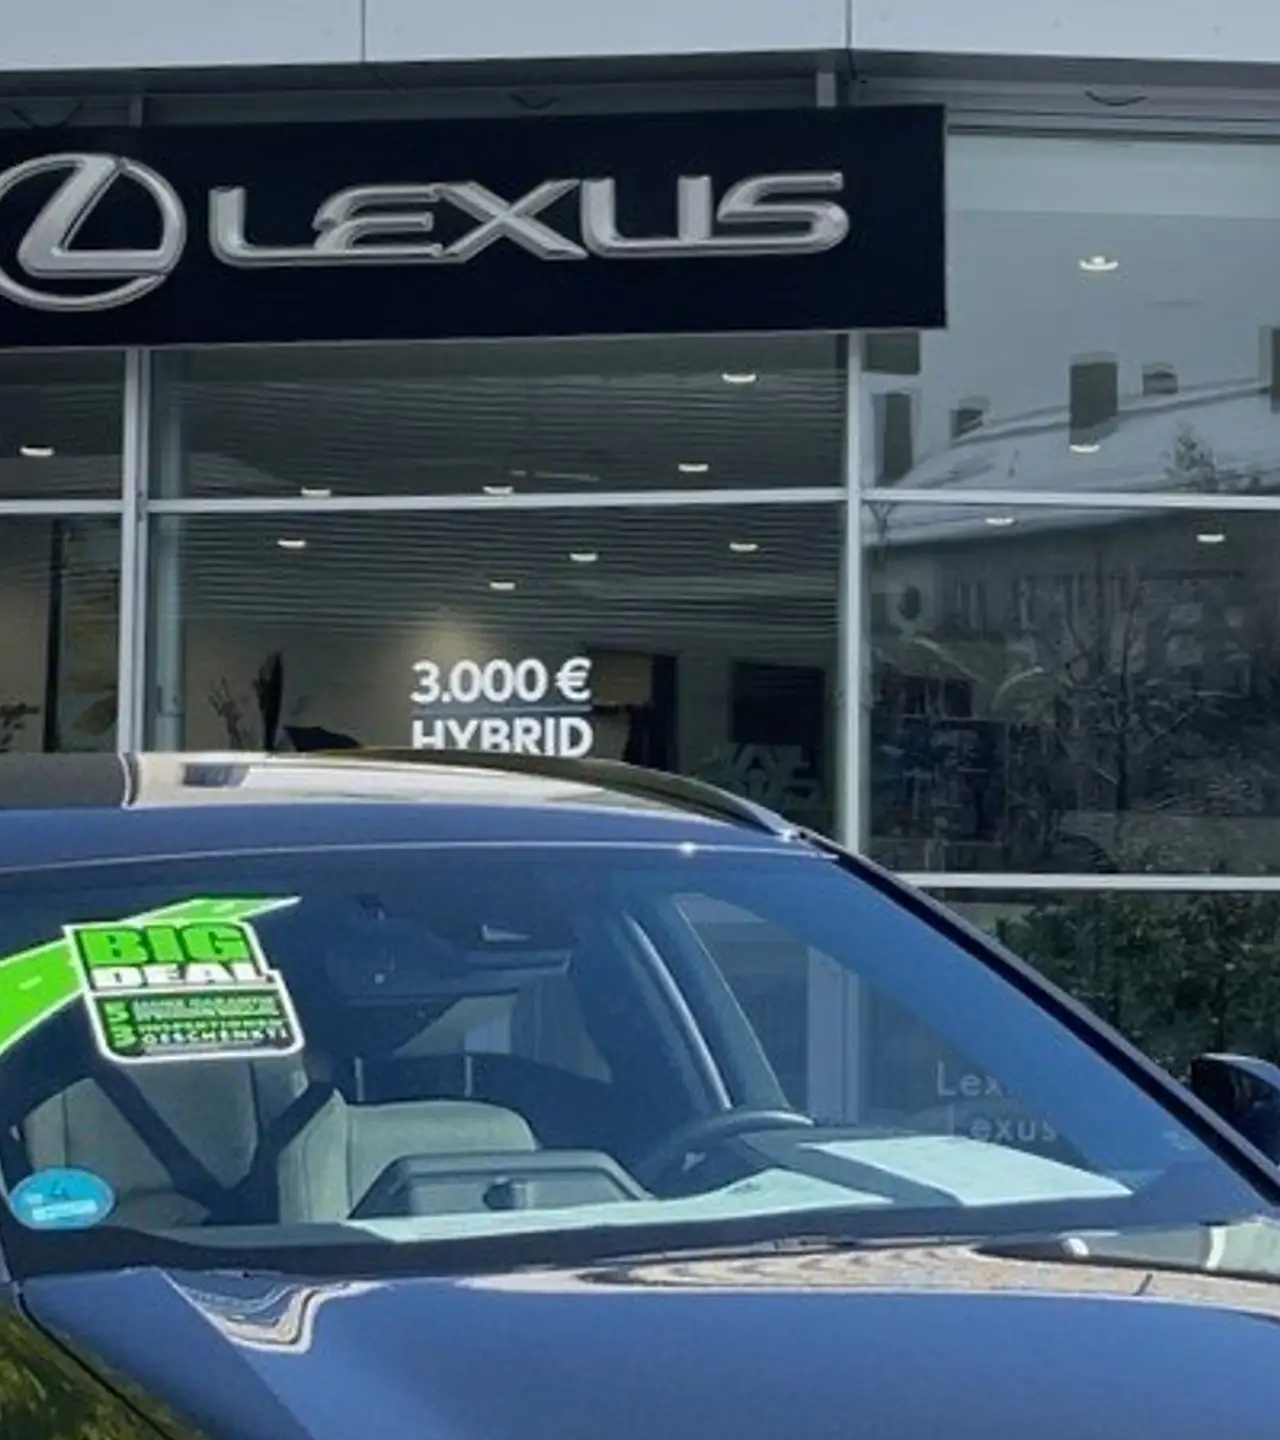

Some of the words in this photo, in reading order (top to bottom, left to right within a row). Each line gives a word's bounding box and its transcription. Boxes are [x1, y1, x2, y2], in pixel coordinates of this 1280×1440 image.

[209, 172, 850, 267] LEXUS
[410, 658, 548, 704] 3.000
[555, 656, 592, 702] €
[411, 715, 595, 757] HYBRID
[80, 925, 252, 964] BIG
[92, 960, 267, 988] DEAL
